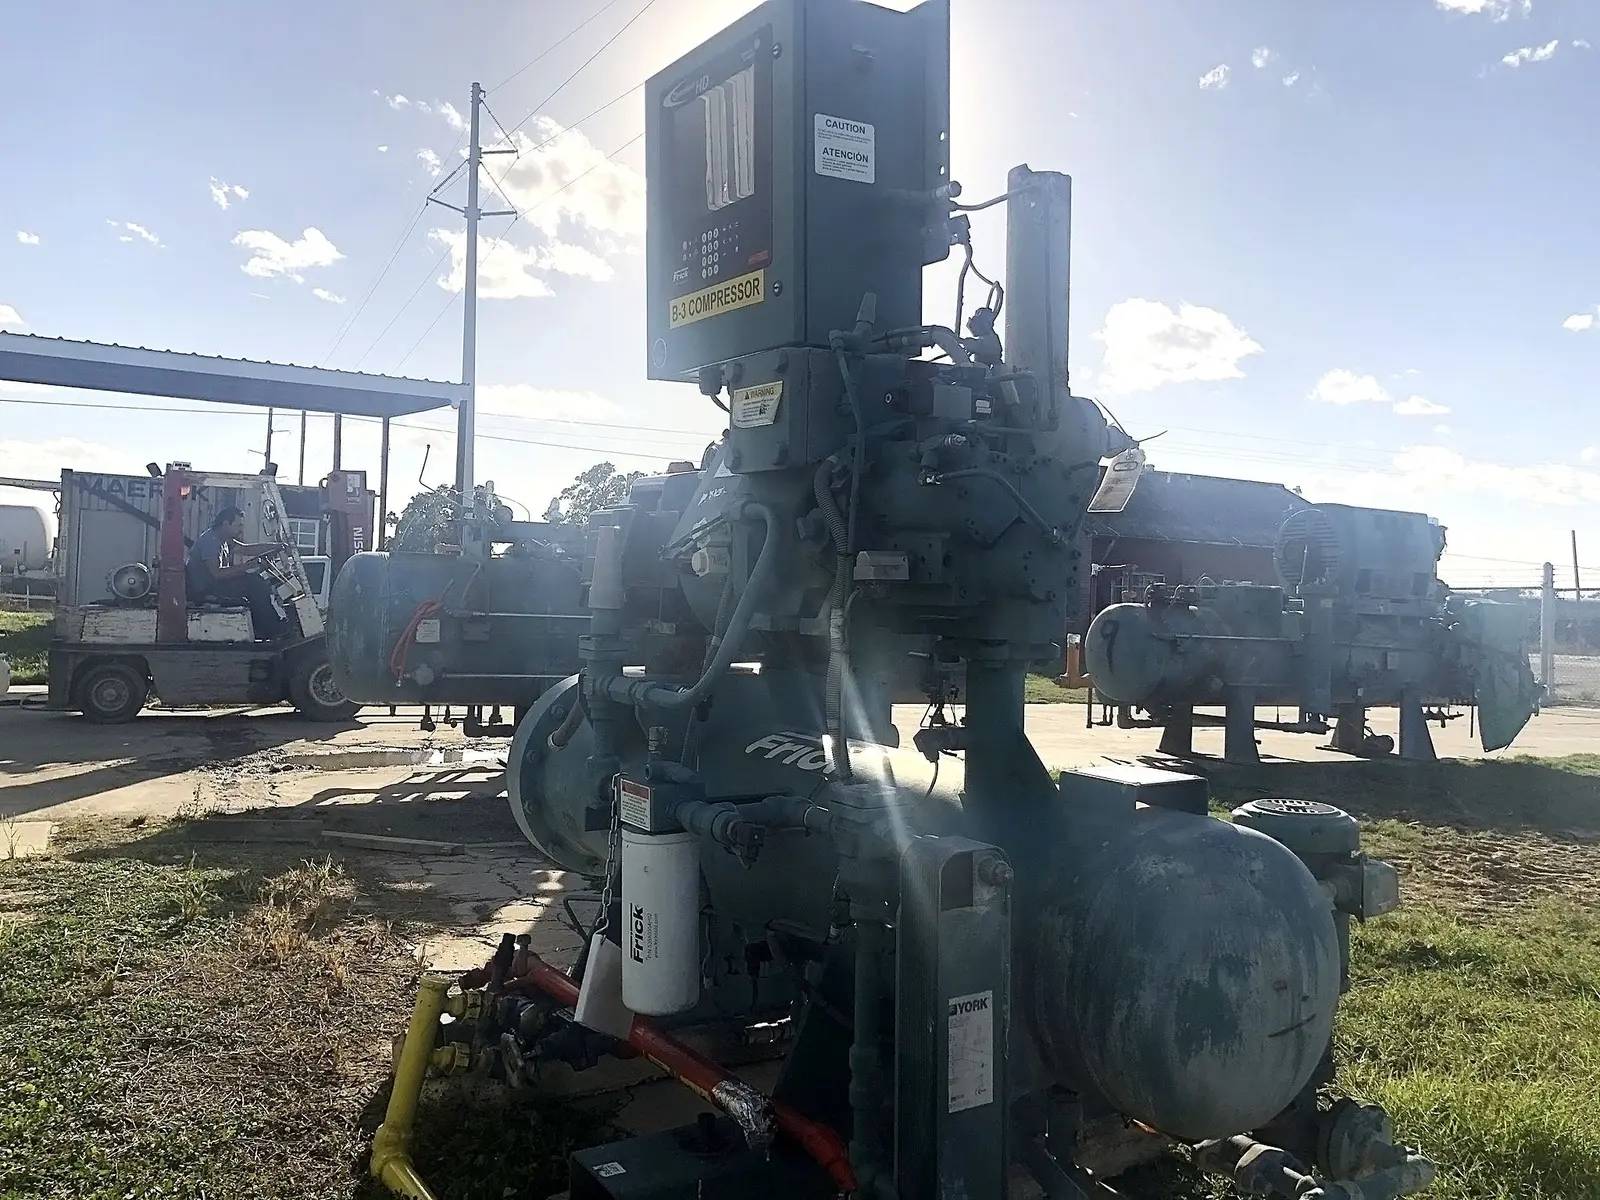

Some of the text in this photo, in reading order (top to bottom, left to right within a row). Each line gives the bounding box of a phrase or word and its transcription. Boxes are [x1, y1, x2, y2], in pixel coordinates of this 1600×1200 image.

[825, 119, 866, 135] CAUTION
[822, 147, 869, 163] ATENCIÓN
[672, 277, 760, 322] B-3 COMPRESSOR
[750, 386, 775, 399] WARNING
[79, 477, 210, 501] MAERK
[630, 903, 644, 964] Frick
[957, 997, 988, 1015] YORK
